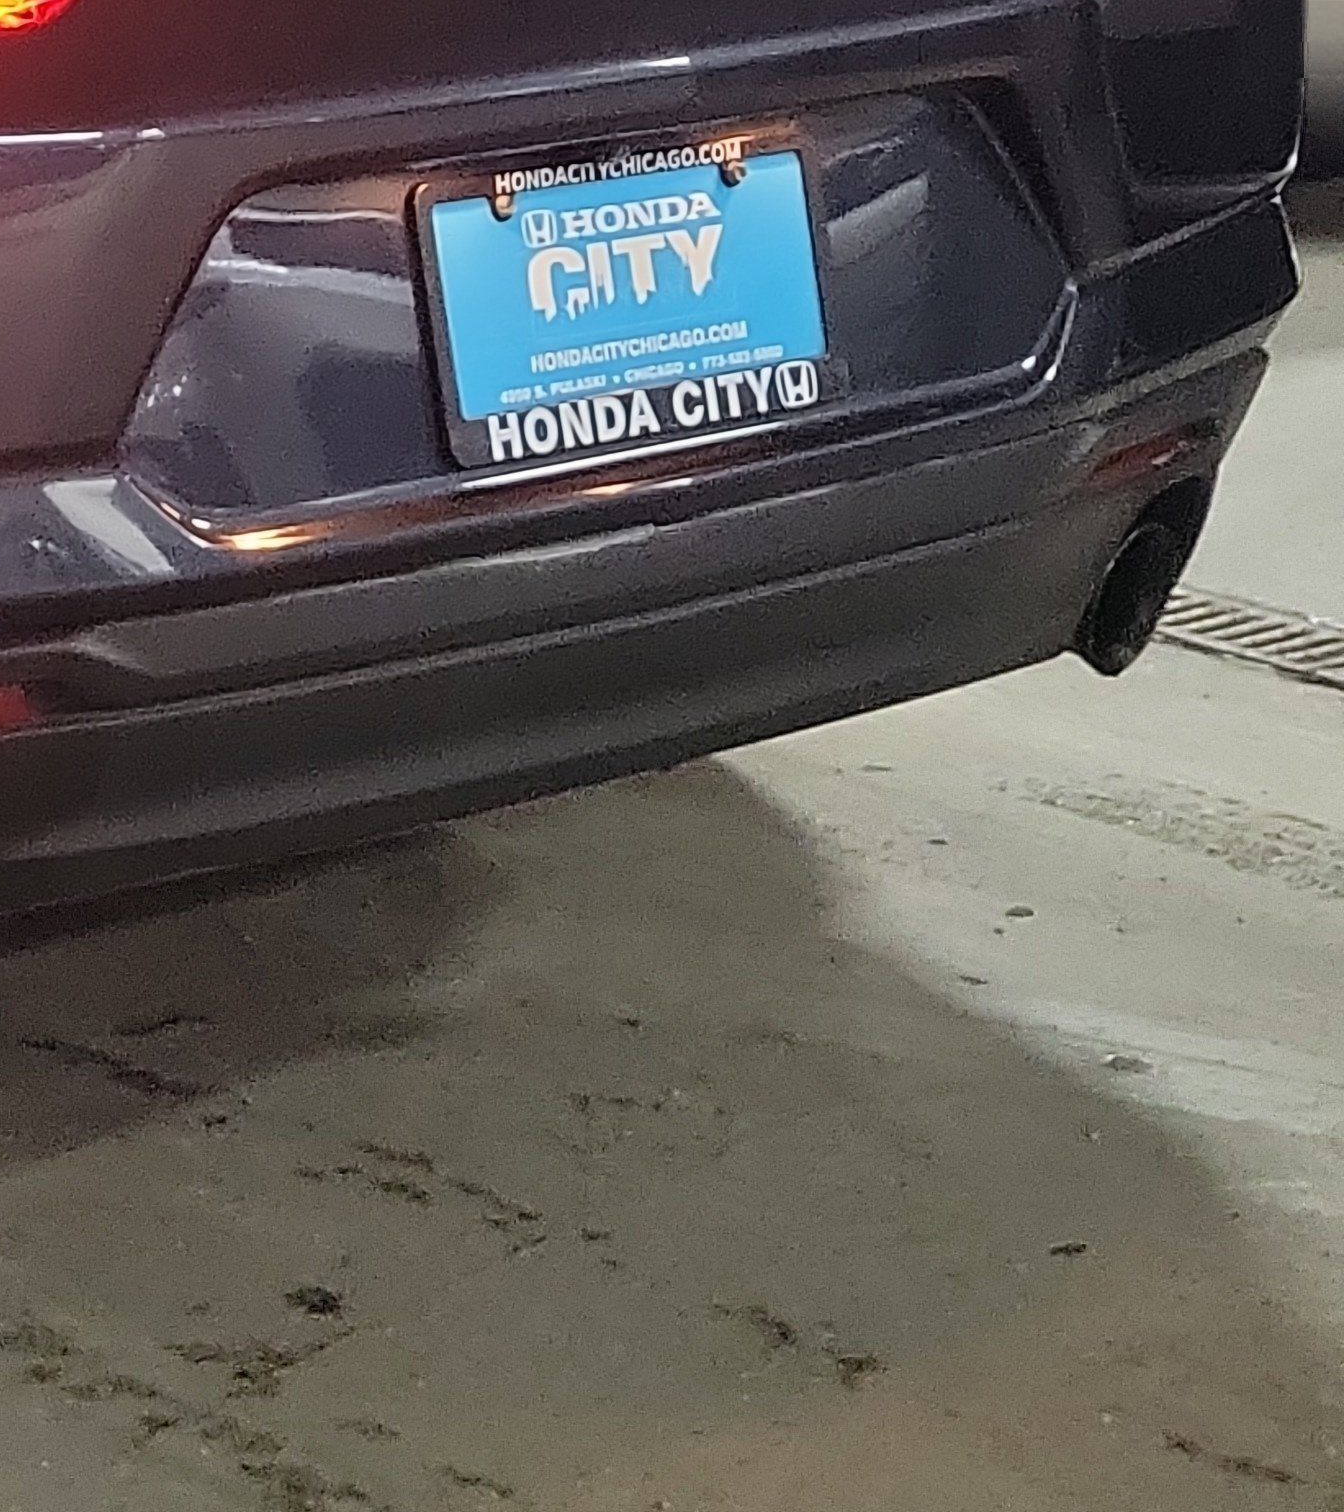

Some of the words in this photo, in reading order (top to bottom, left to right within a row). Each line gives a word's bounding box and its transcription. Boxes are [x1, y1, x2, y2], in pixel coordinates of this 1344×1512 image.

[561, 192, 722, 239] HONDA
[527, 223, 724, 323] CITY
[530, 320, 748, 375] HONDACITYCHICAGO.COM
[549, 373, 607, 399] PULASKI
[623, 360, 685, 384] CHICAGO
[487, 386, 661, 463] HONDA
[671, 366, 773, 427] CITY
